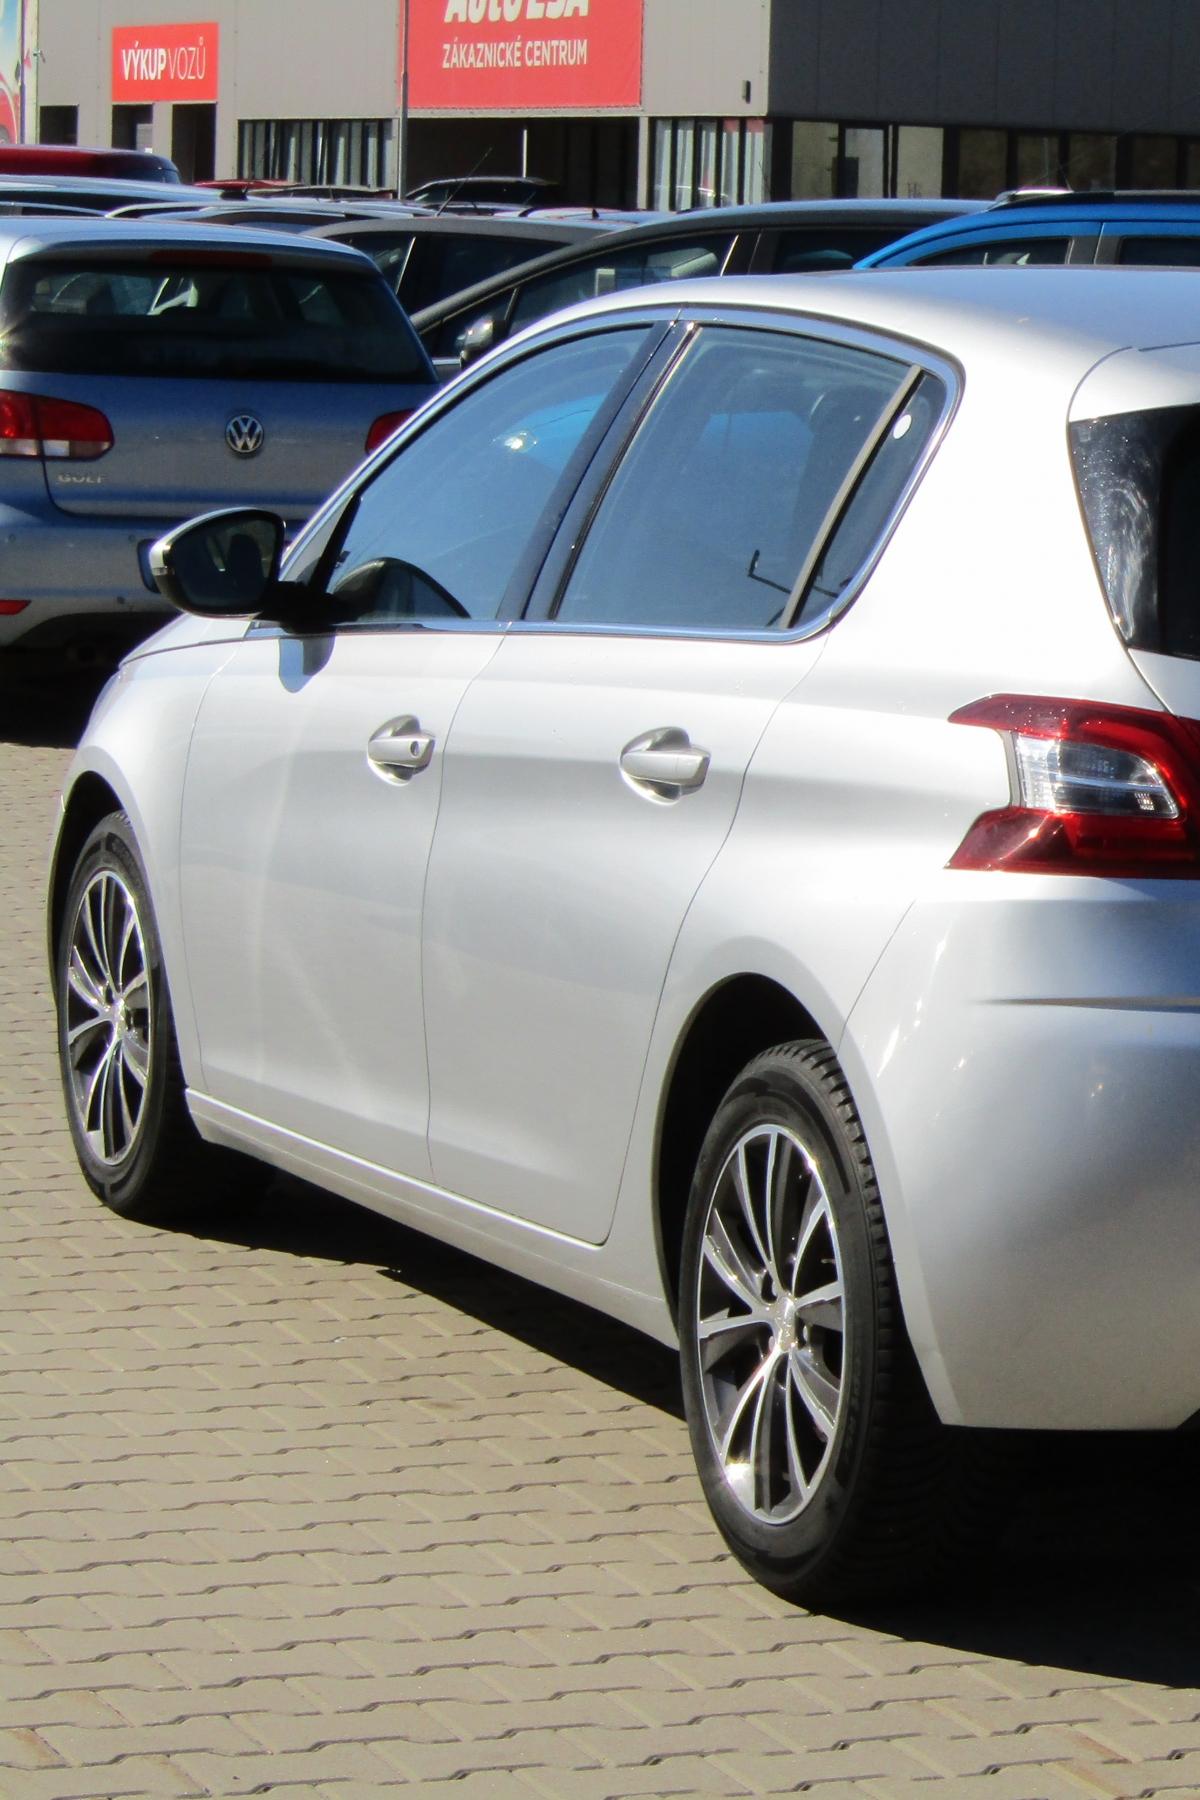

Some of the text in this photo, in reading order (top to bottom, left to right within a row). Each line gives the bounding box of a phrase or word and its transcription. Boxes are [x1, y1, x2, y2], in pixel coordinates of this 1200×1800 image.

[122, 41, 167, 81] VÝKUP
[442, 35, 588, 68] ZÁKAZNICKÉ CENTRUM
